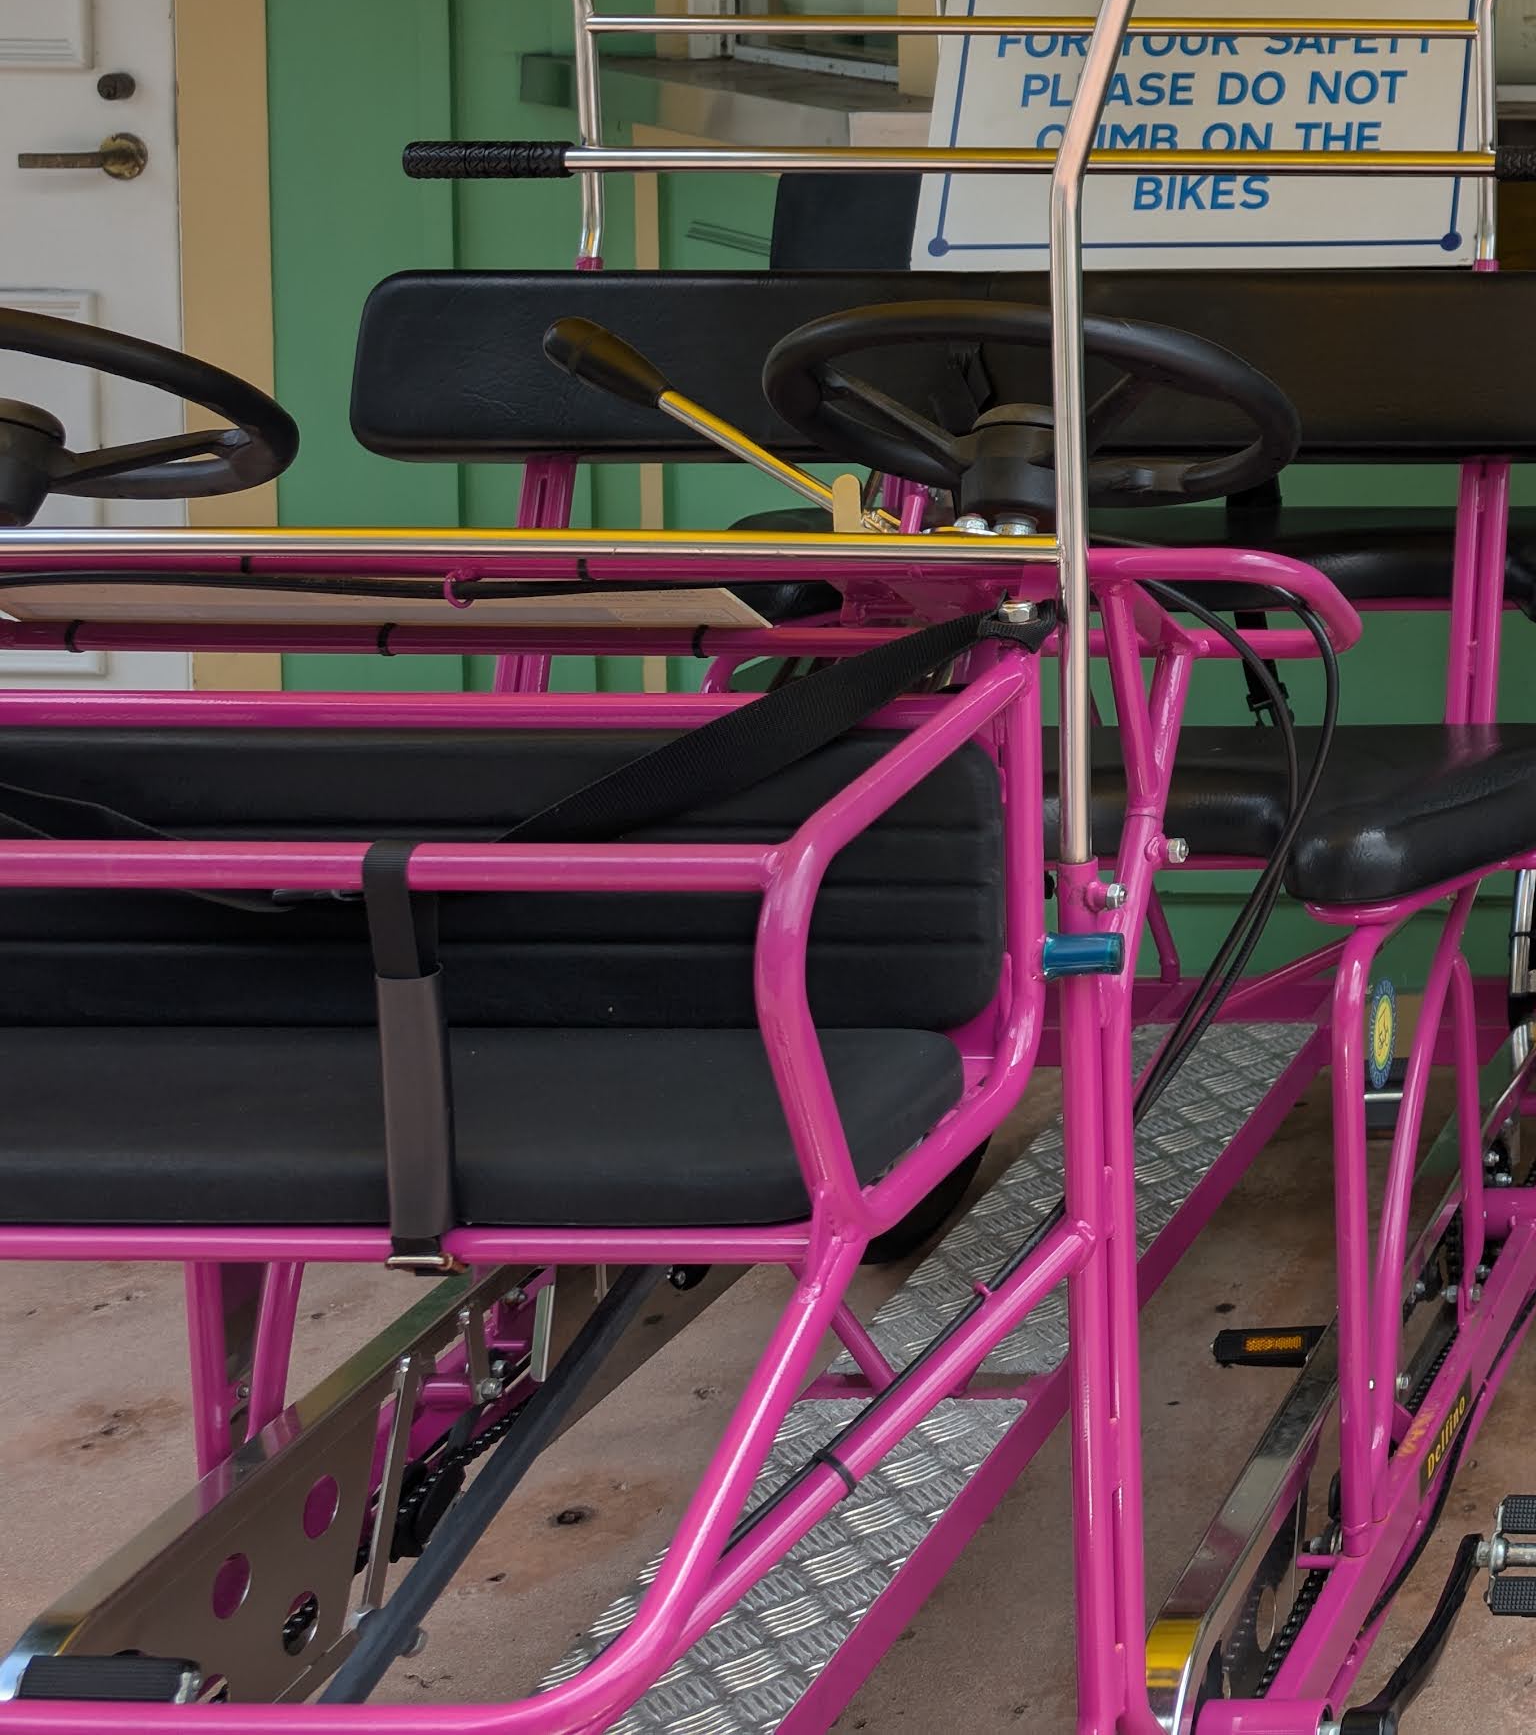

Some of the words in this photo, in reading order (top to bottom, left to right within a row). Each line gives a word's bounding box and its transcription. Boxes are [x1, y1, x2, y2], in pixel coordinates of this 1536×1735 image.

[1217, 72, 1286, 106] DO
[1308, 70, 1408, 105] NOT
[1202, 123, 1273, 150] ON
[1295, 121, 1382, 151] THE
[1133, 175, 1270, 211] BIKES
